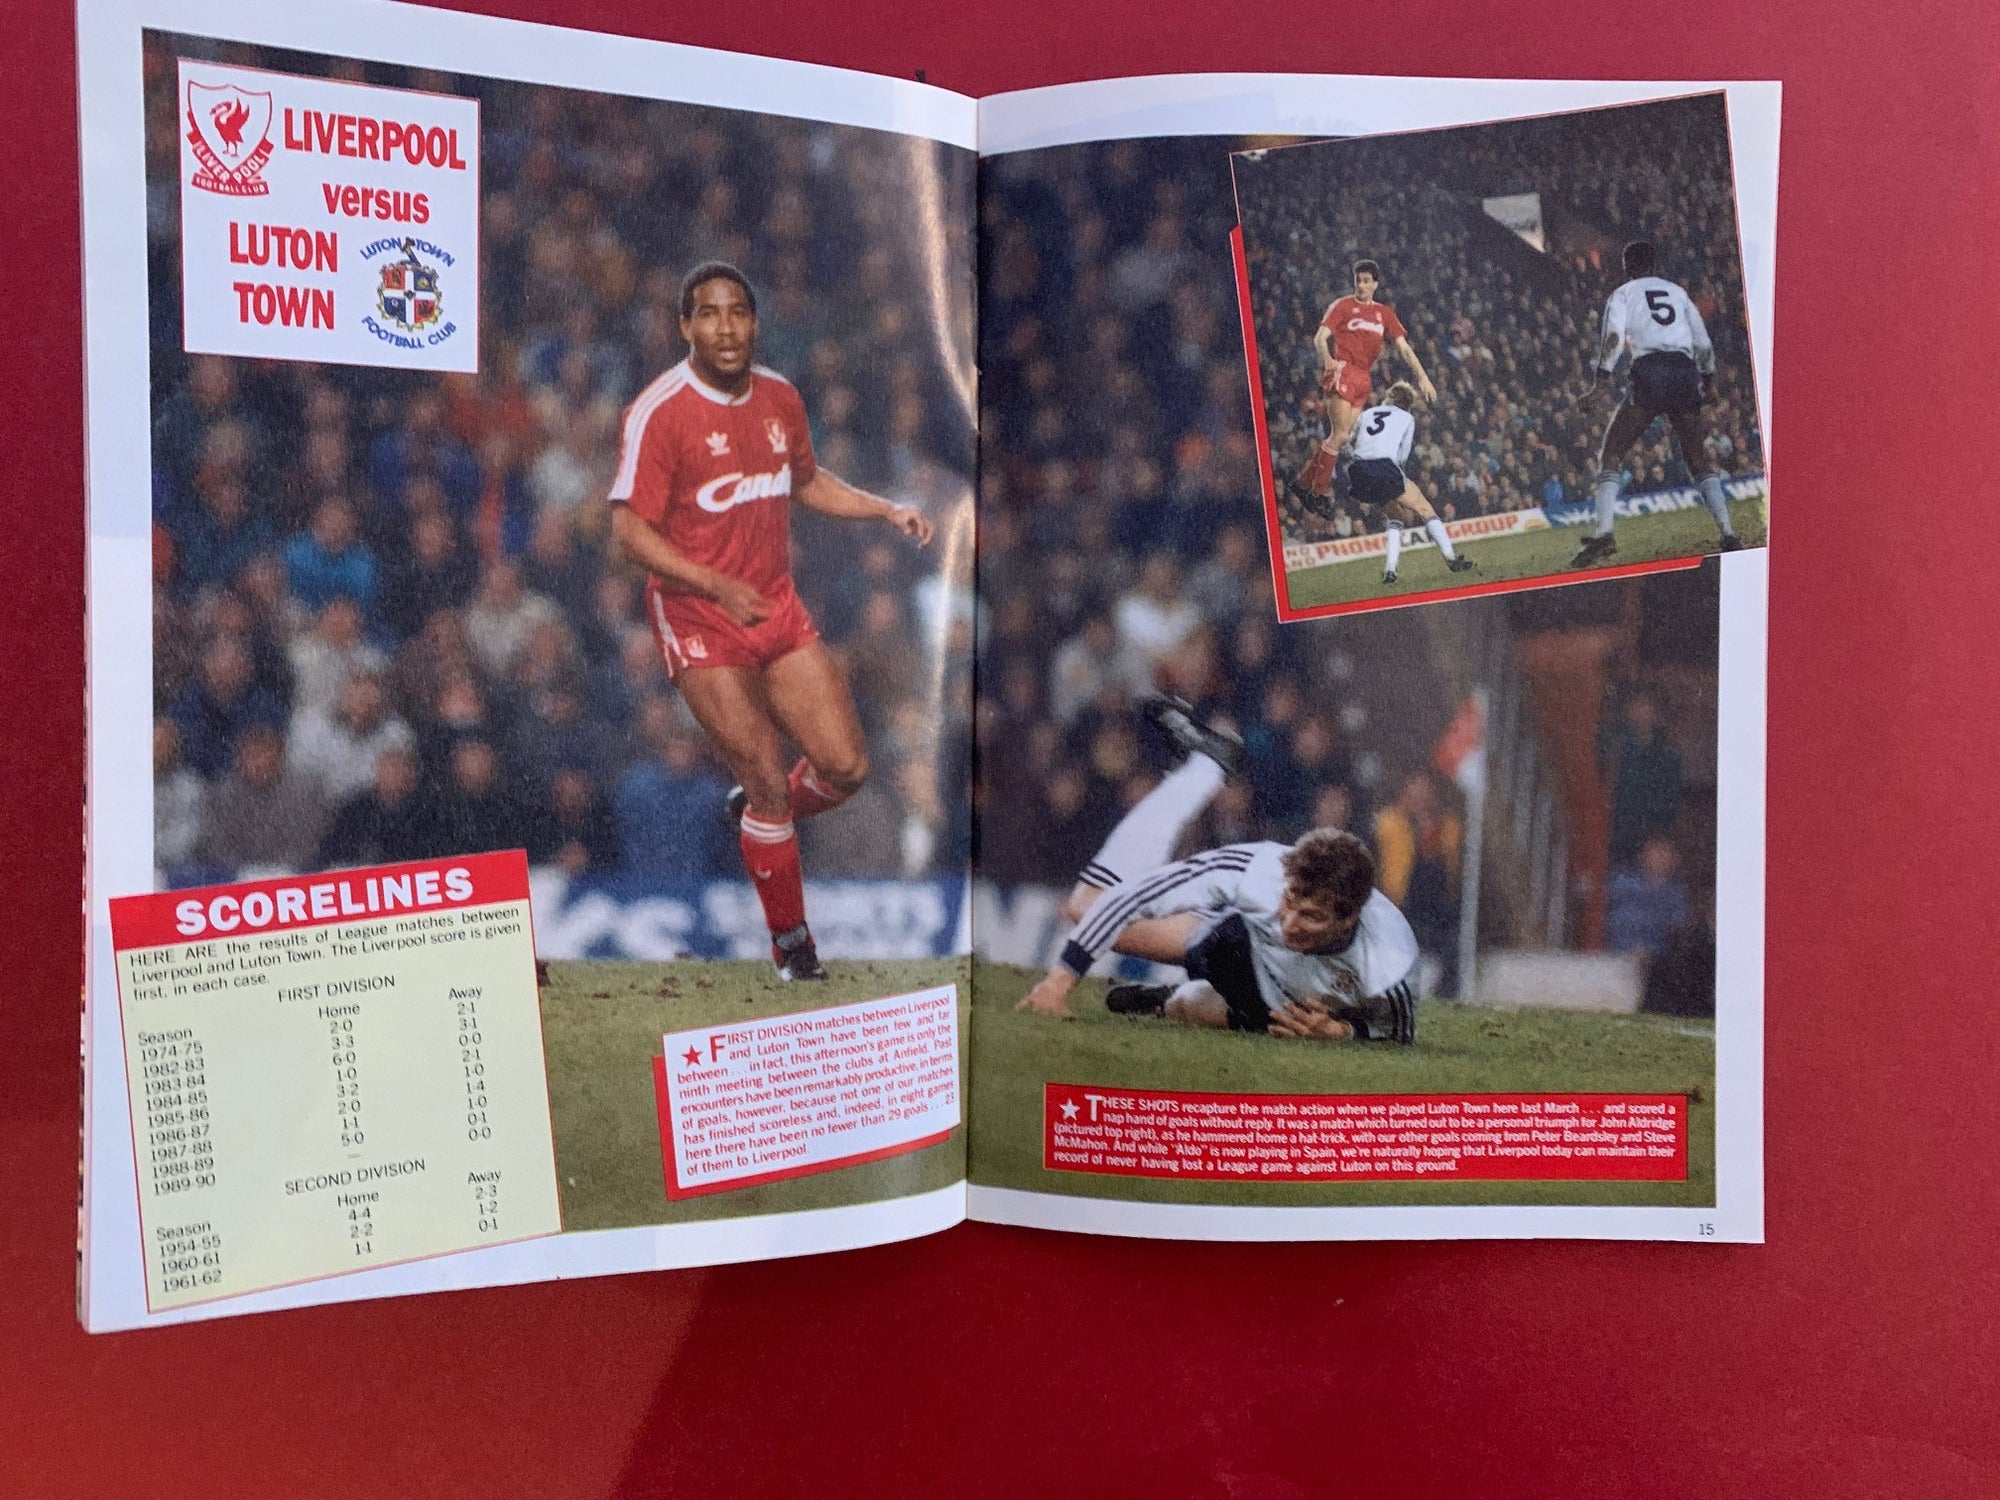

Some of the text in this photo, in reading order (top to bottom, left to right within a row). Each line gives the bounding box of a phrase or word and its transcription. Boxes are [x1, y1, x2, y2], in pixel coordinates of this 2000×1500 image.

[283, 108, 466, 170] LIVERPOOL
[322, 183, 430, 224] versus
[229, 222, 338, 273] LUTON
[360, 237, 455, 267] LUTON TOWN
[233, 281, 334, 330] TOWN
[1645, 290, 1676, 326] 5
[362, 316, 456, 349] FOOTBALL CLUB
[1367, 412, 1391, 436] 3
[1448, 515, 1518, 538] GROUP
[175, 867, 474, 935] SCORELINES
[130, 907, 520, 967] HERE ARE the results of League matches between
[132, 922, 521, 984] Liverpool and Luton Town. The Liverpool score is given
[133, 973, 270, 1001] first, in each case.
[278, 975, 395, 1003] FIRST DIVISION
[318, 986, 482, 1019] Home Away
[138, 1028, 192, 1046] Season
[710, 1030, 754, 1062] FIRST
[758, 1021, 813, 1041] DIVISION
[816, 1014, 860, 1031] matches
[862, 1005, 906, 1022] between
[729, 1047, 750, 1060] and
[757, 1042, 790, 1056] Luton
[797, 1036, 825, 1048] Town
[830, 1031, 856, 1042] have
[862, 1025, 888, 1037] been
[894, 1020, 911, 1030] few
[917, 1014, 934, 1026] and
[684, 1081, 954, 1145] has finished scoreless and, indeed, in eight games
[1084, 1094, 1676, 1121] THESE SHOTS recapture the match action when we played Luton Town here last March and scored a
[685, 1102, 928, 1160] here there have been no fewer than 29 goals
[285, 1159, 426, 1195] SECOND DIVISION
[687, 1143, 810, 1176] of them to Liverpool.
[1054, 1152, 1458, 1175] record of never having lost a League game against Luton on this ground.
[337, 1170, 501, 1208] Home Away
[157, 1222, 210, 1241] Season
[1698, 1223, 1714, 1236] 15
